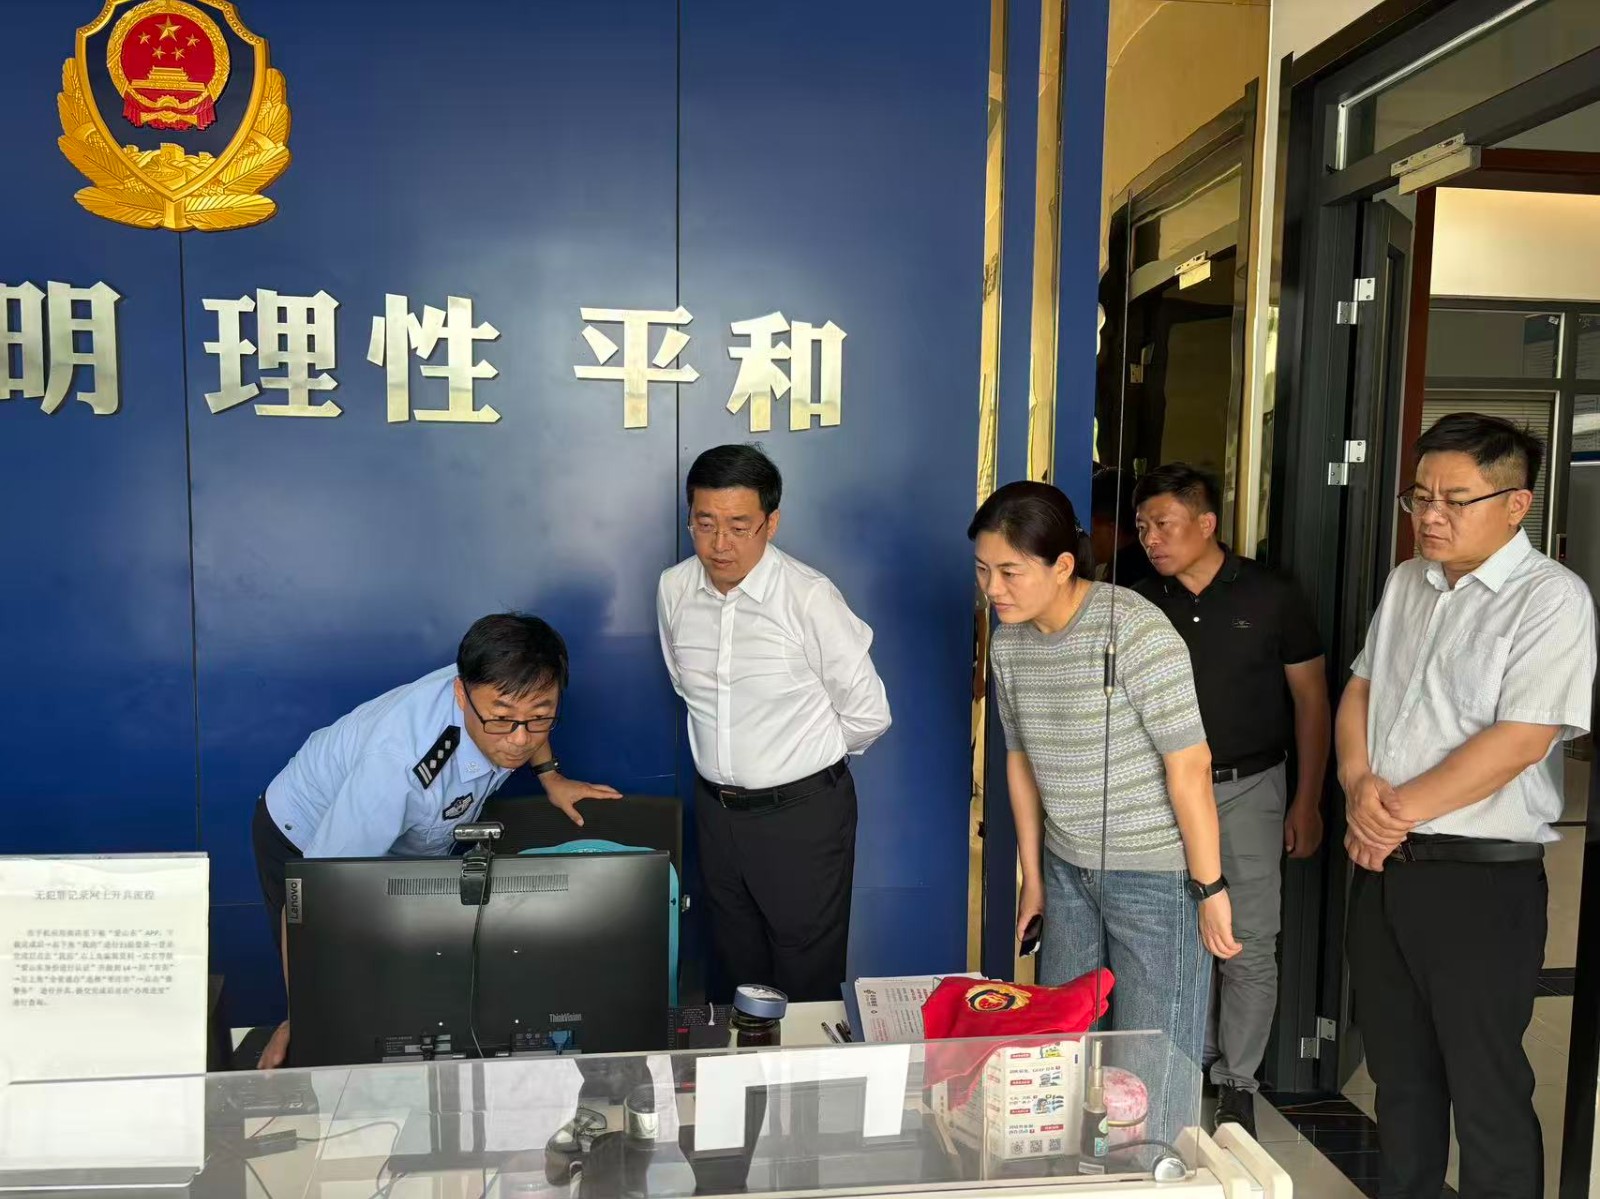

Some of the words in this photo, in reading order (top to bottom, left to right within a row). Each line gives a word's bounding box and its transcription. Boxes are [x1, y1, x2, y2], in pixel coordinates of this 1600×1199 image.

[0, 280, 121, 415] 明
[202, 288, 502, 425] 理性
[573, 304, 848, 432] 平和
[289, 881, 299, 920] Lenovo
[549, 1012, 582, 1023] ThinkVision
